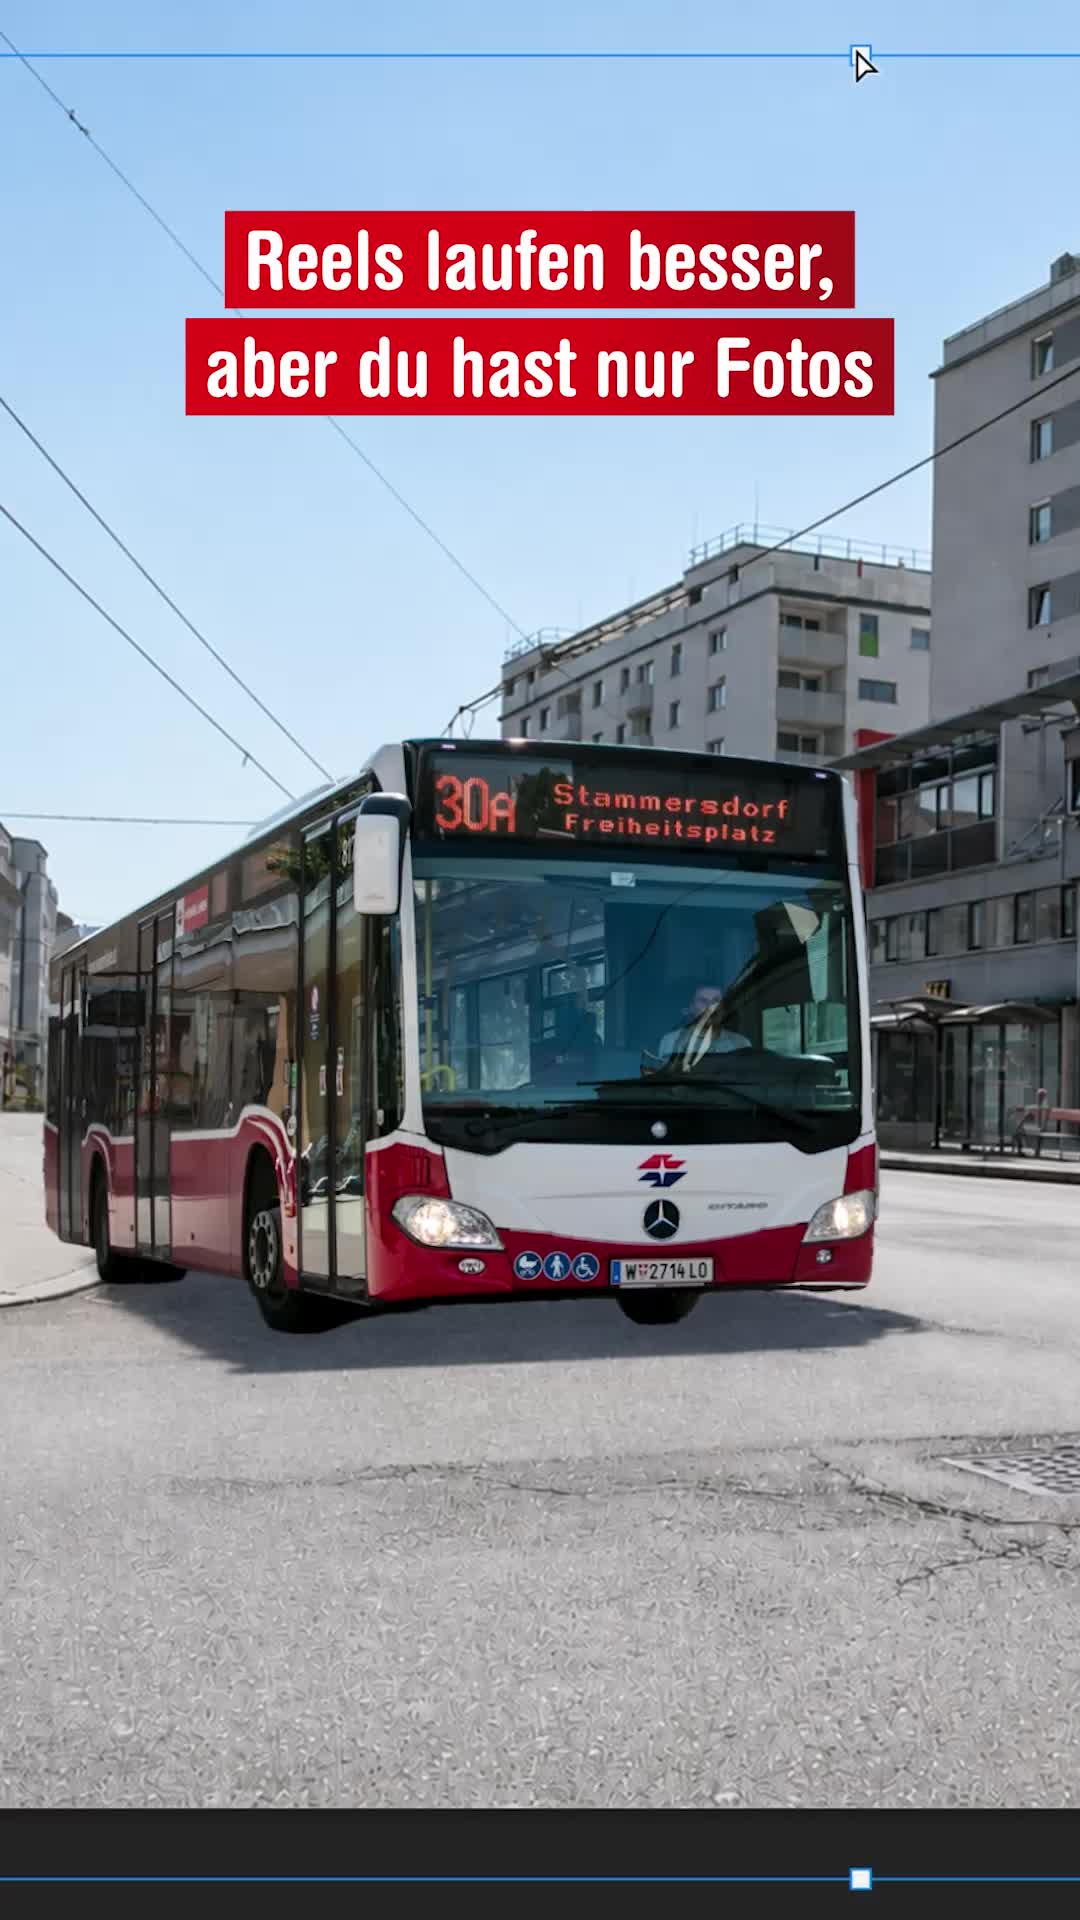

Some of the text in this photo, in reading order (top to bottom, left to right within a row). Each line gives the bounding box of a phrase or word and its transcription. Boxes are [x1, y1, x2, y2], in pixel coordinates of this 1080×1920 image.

[435, 775, 517, 833] 30A
[553, 783, 789, 819] Stammersdorf
[565, 813, 777, 844] Freiheitsplatz
